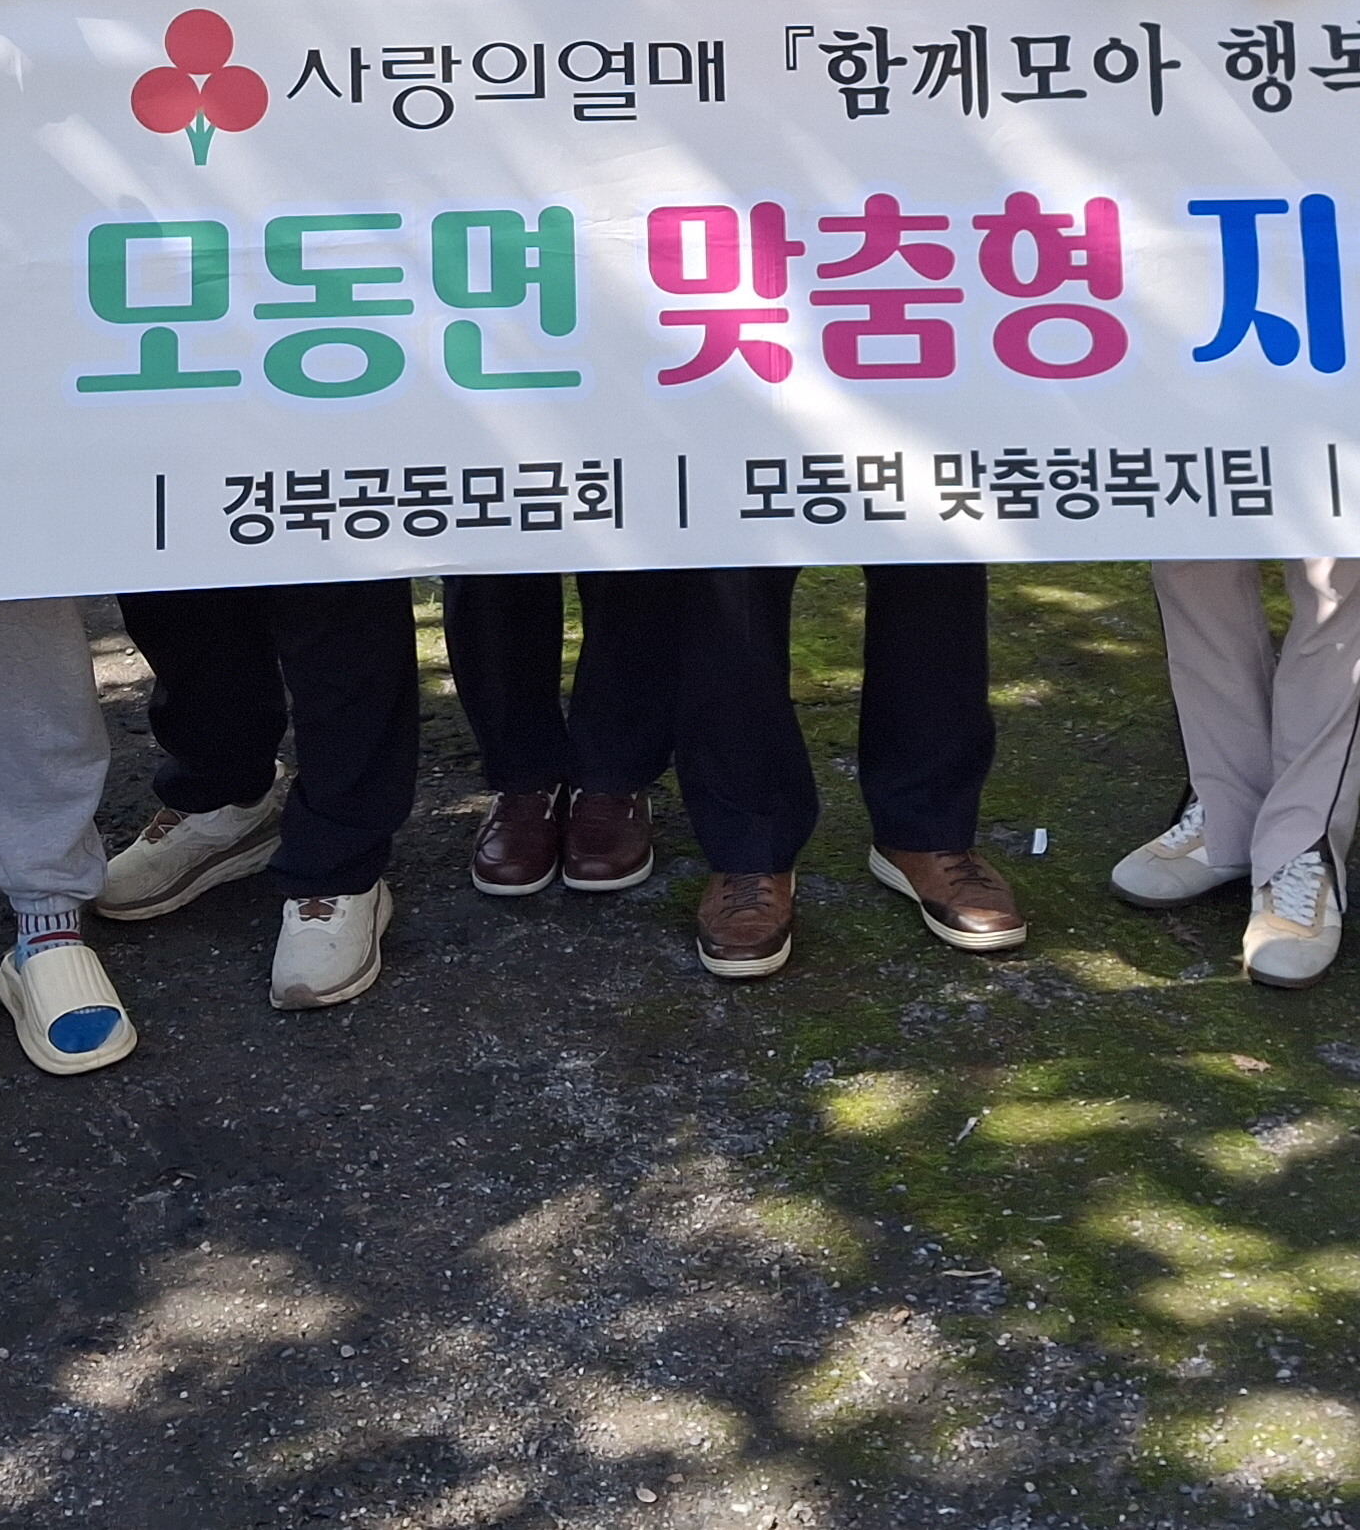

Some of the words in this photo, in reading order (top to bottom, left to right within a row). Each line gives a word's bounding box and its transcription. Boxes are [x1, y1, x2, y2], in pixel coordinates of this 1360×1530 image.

[285, 39, 727, 131] 사랑의열매
[784, 20, 1182, 121] 『함께모아
[75, 206, 582, 400] 모동면
[647, 190, 1128, 386] 맞춤형
[221, 457, 624, 546] 경북공동모금회
[739, 451, 907, 526] 모동면
[933, 445, 1274, 522] 맞춤형복지팀
